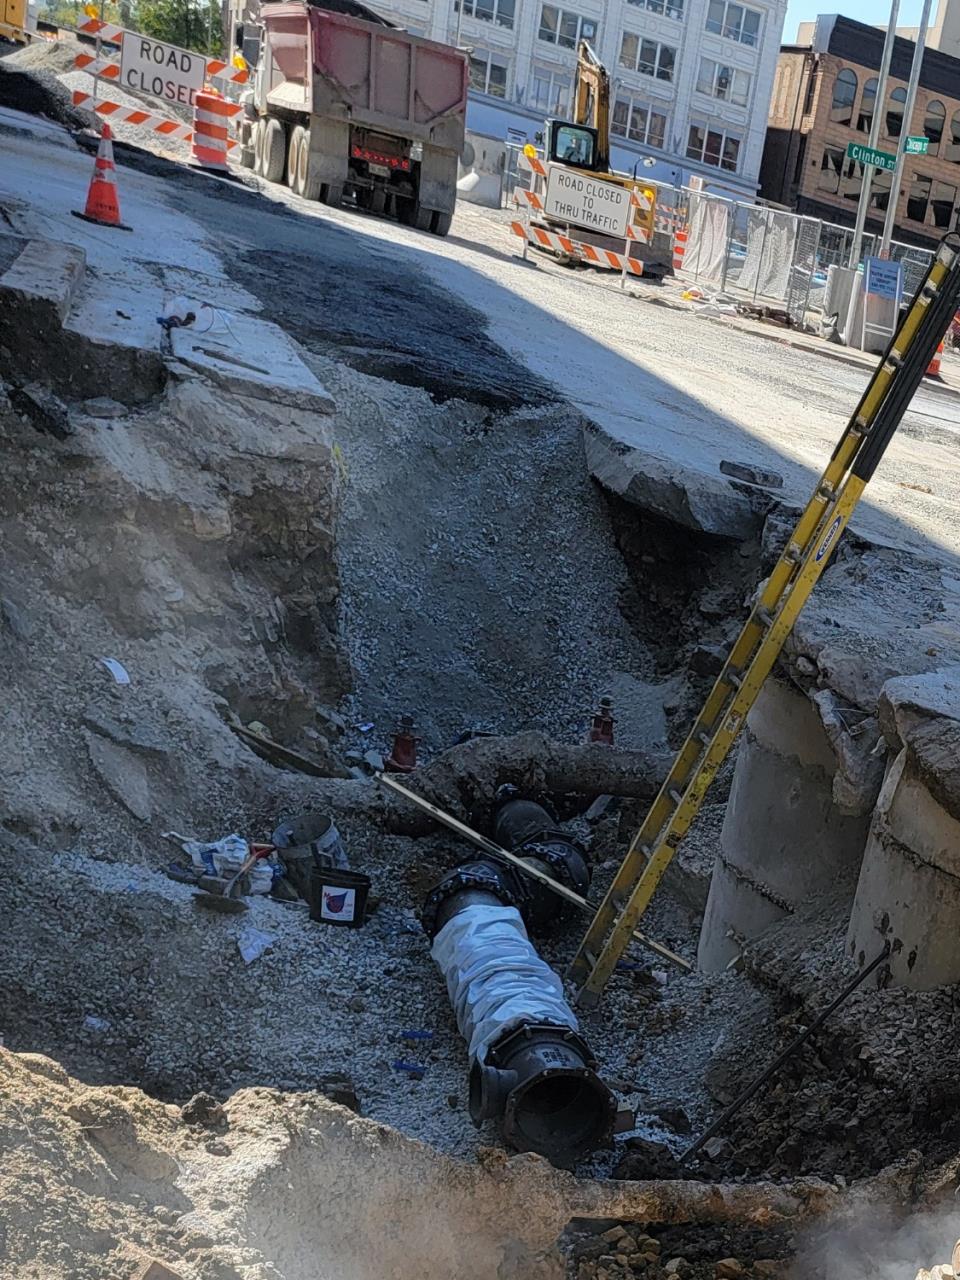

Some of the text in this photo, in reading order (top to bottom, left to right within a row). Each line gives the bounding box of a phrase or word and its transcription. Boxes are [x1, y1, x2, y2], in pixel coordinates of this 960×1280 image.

[140, 41, 192, 73] ROAD
[852, 146, 885, 167] Clinton
[558, 174, 622, 204] ROAD CLOSED
[583, 195, 594, 209] TO
[555, 200, 619, 231] THRU TRAFFIC
